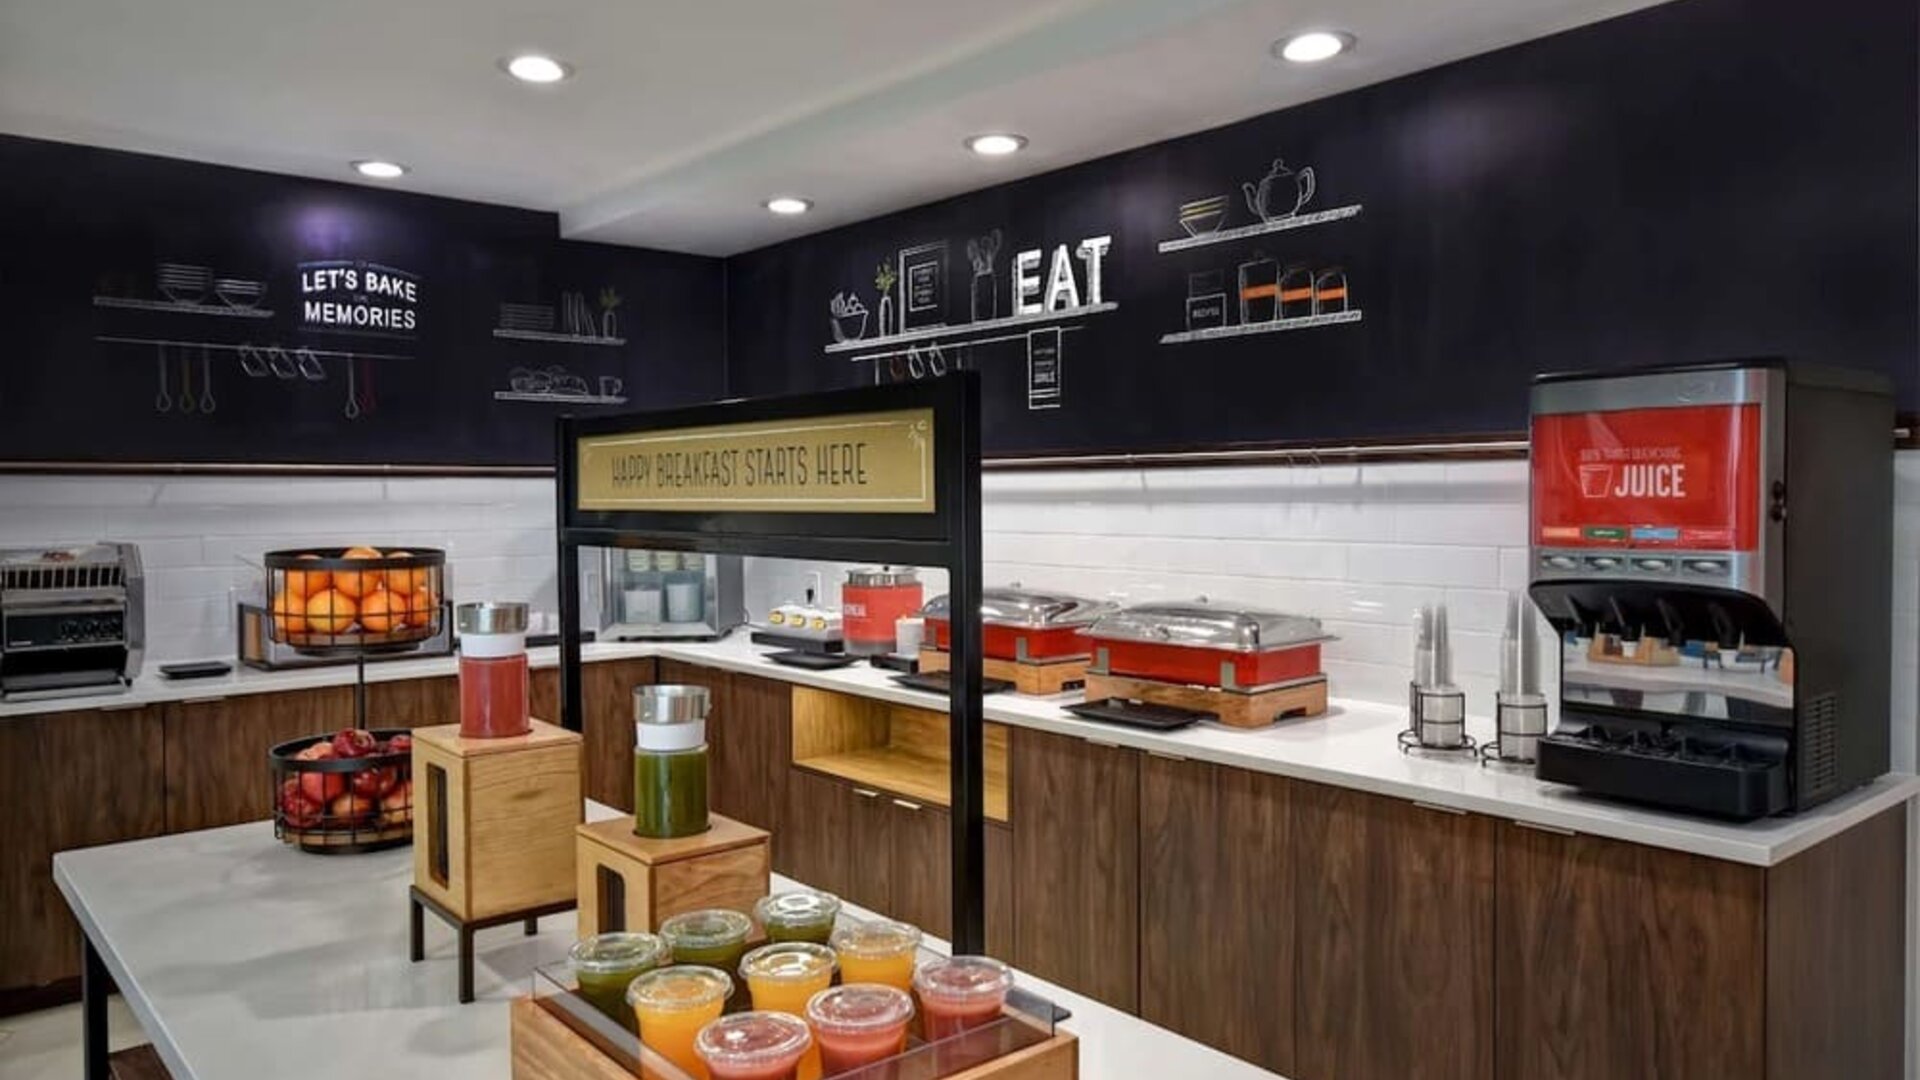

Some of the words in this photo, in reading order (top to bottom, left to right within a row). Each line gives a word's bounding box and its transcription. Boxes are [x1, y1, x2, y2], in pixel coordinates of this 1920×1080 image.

[302, 268, 358, 293] LET'S
[366, 271, 417, 302] BAKE
[1012, 235, 1111, 315] EAT
[304, 301, 416, 329] MEMORIES
[611, 453, 651, 488] HAPPY
[656, 449, 739, 488] BREAKFAST
[745, 446, 807, 486] STARTS
[816, 442, 867, 485] HERE
[1614, 464, 1686, 497] JUICE
